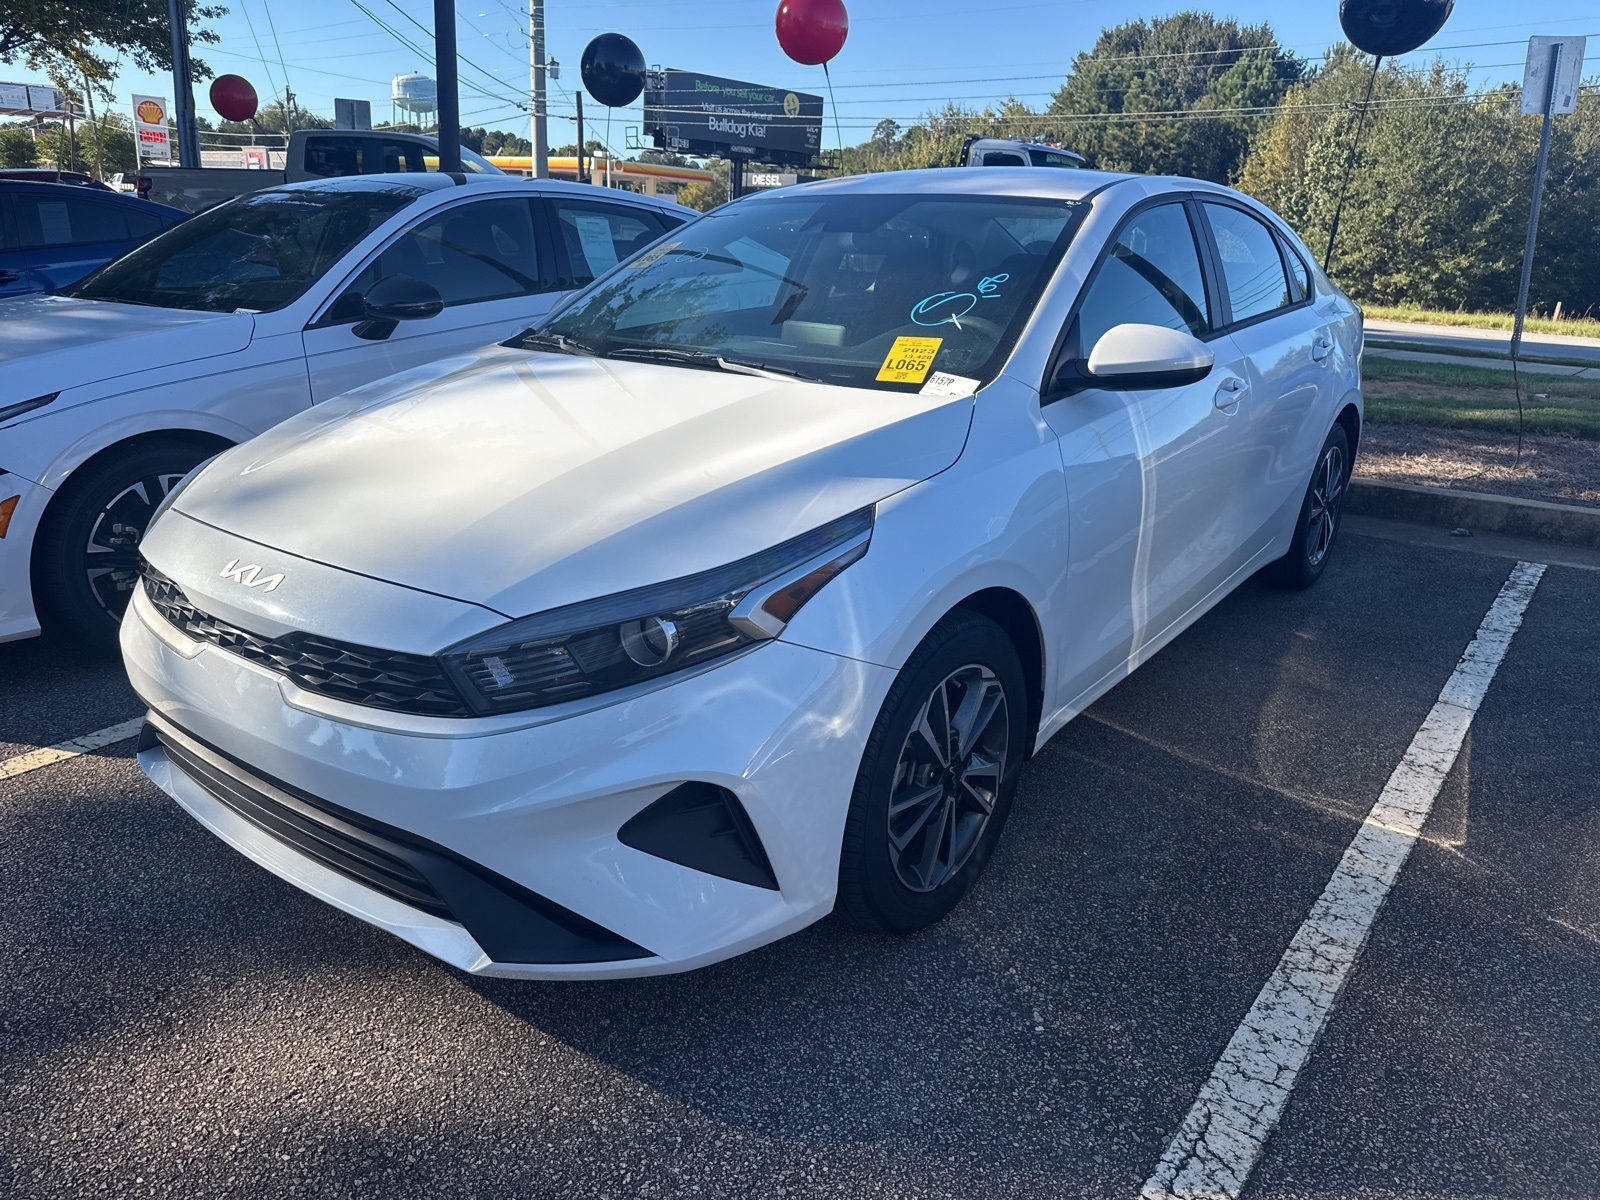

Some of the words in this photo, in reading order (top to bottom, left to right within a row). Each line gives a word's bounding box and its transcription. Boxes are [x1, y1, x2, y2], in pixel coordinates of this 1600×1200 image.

[695, 80, 720, 94] Before
[722, 86, 735, 98] you
[736, 87, 748, 99] sell
[749, 90, 764, 103] your
[701, 102, 714, 112] Visit
[715, 104, 722, 113] us
[722, 105, 741, 116] across
[708, 116, 747, 138] Bulldog
[748, 123, 766, 138] Kia!
[752, 174, 782, 186] DIESEL
[886, 358, 927, 371] L065
[929, 375, 955, 387] 6157P
